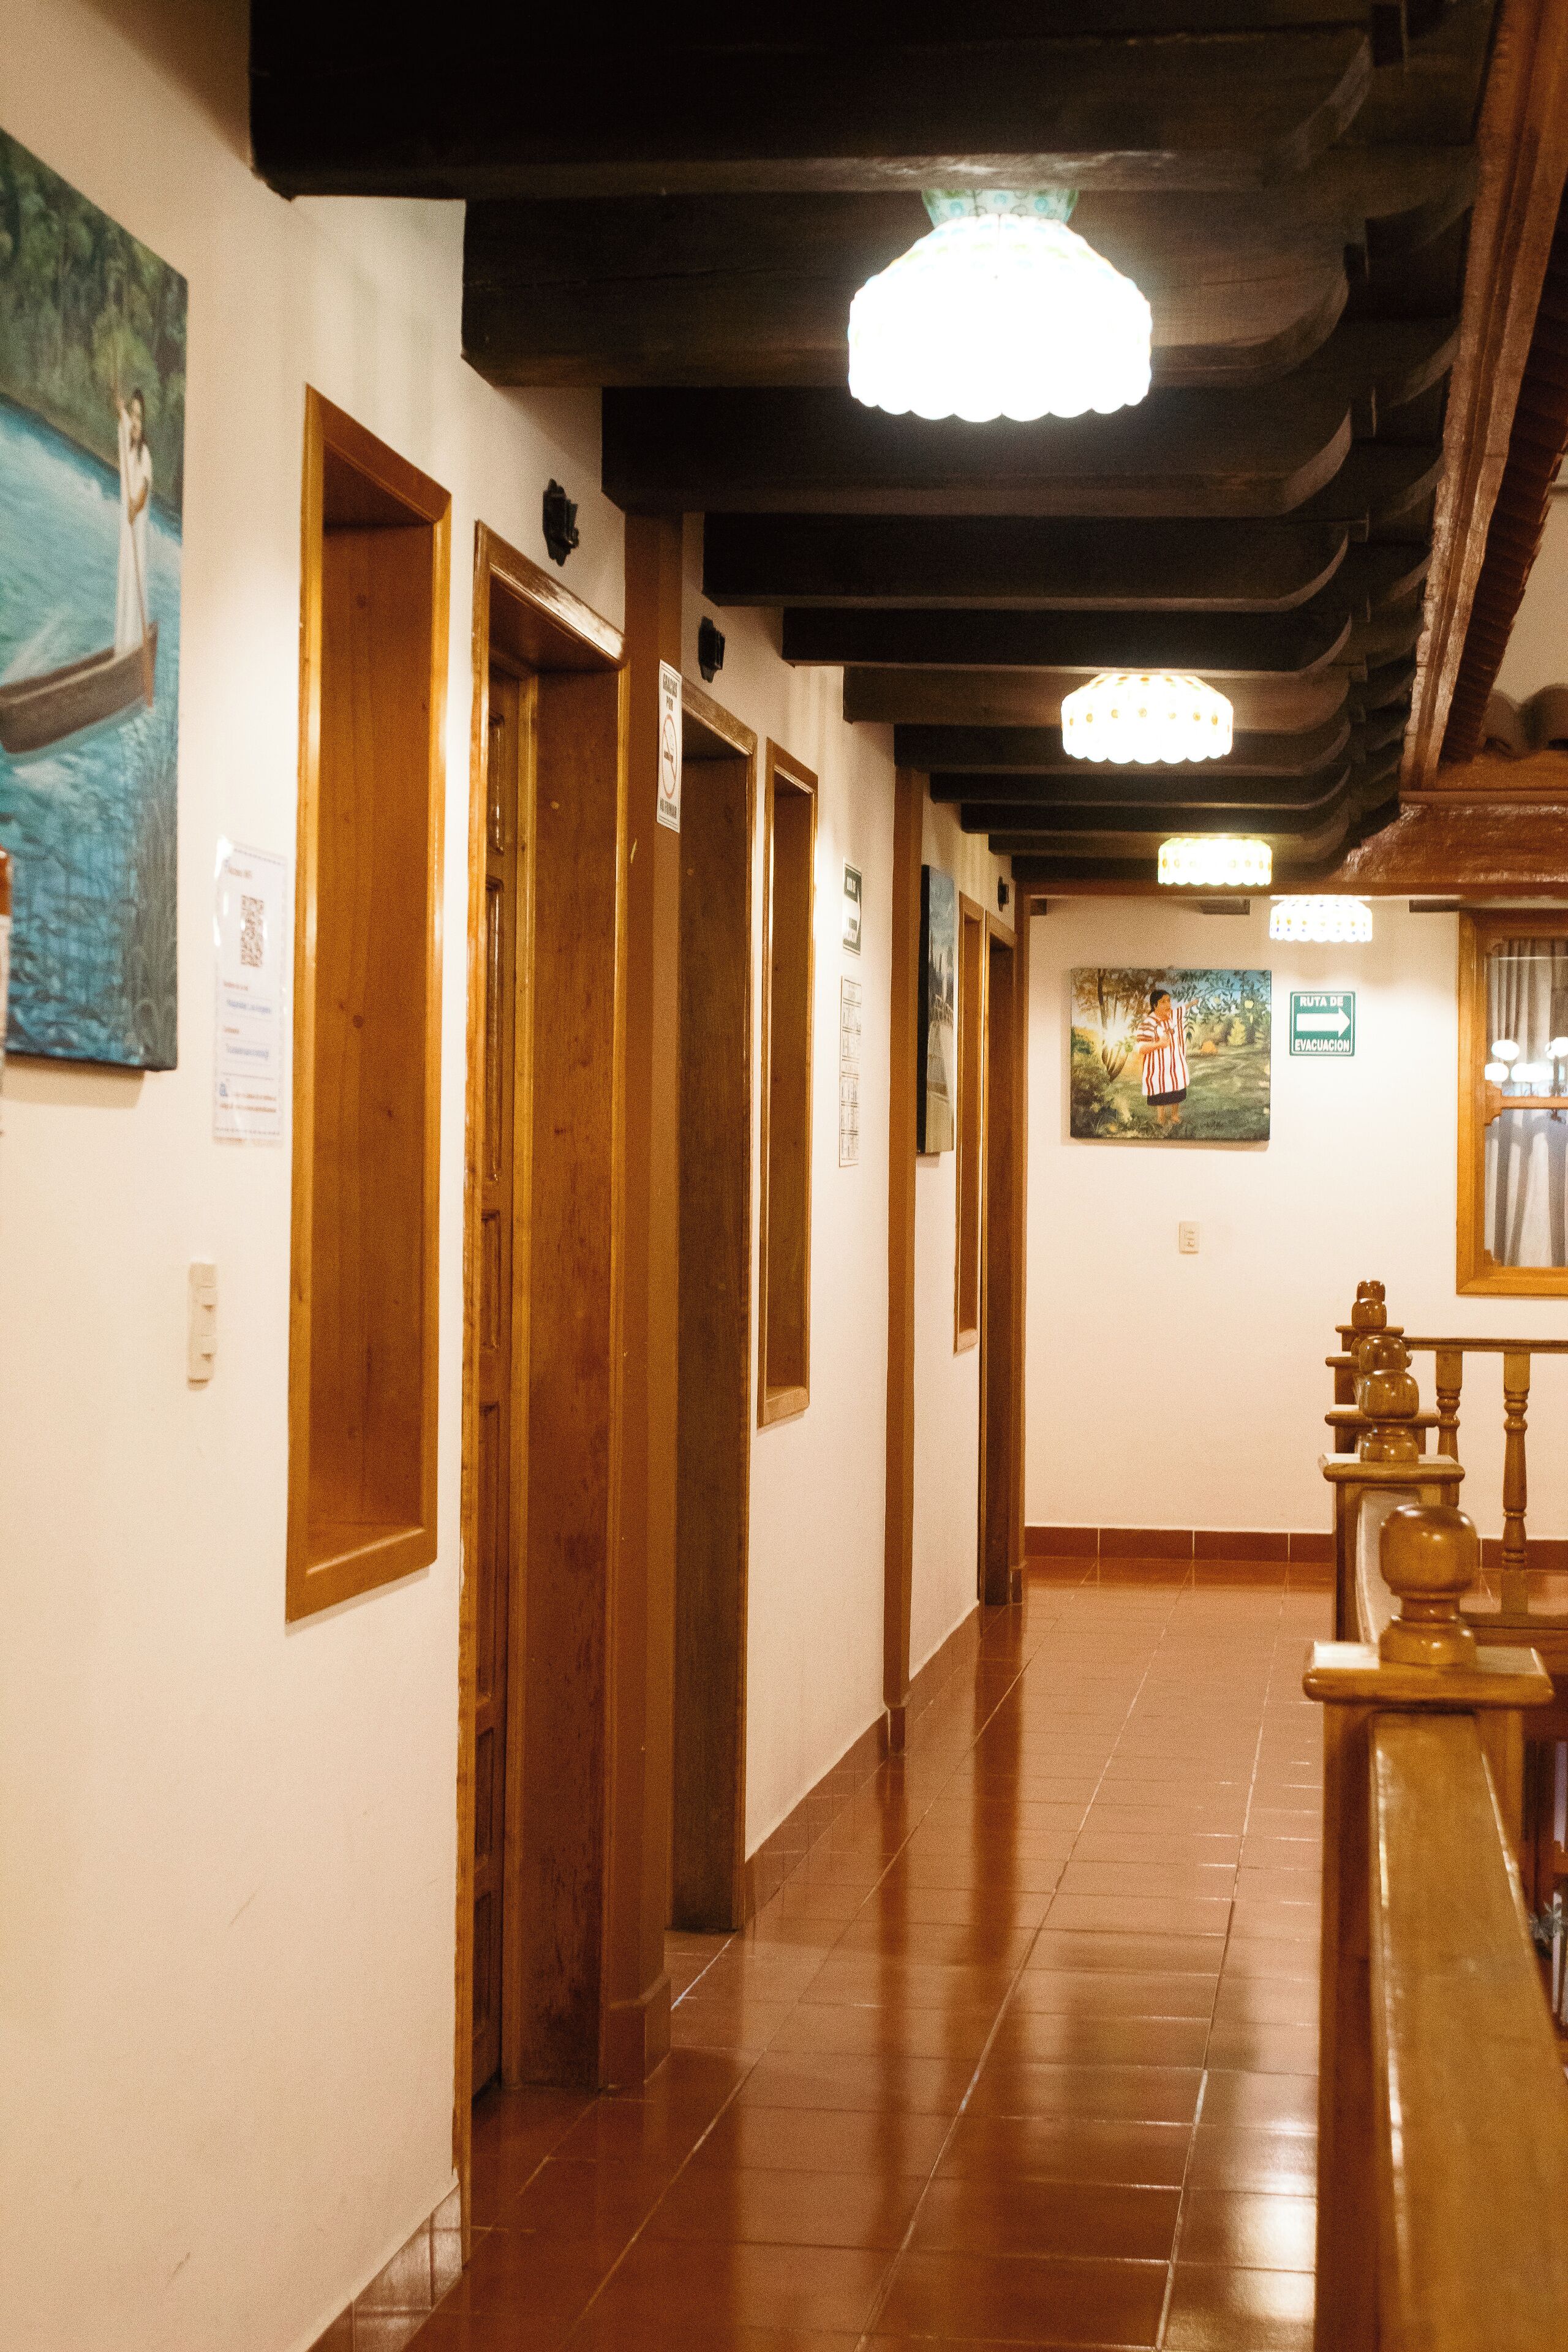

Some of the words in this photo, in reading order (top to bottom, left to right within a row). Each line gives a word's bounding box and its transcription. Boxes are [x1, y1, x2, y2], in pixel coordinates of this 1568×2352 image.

[663, 673, 677, 698] GRACIAS
[1300, 996, 1327, 1006] RUTA
[1330, 996, 1344, 1006] DE
[1295, 1039, 1350, 1052] EVACUACION
